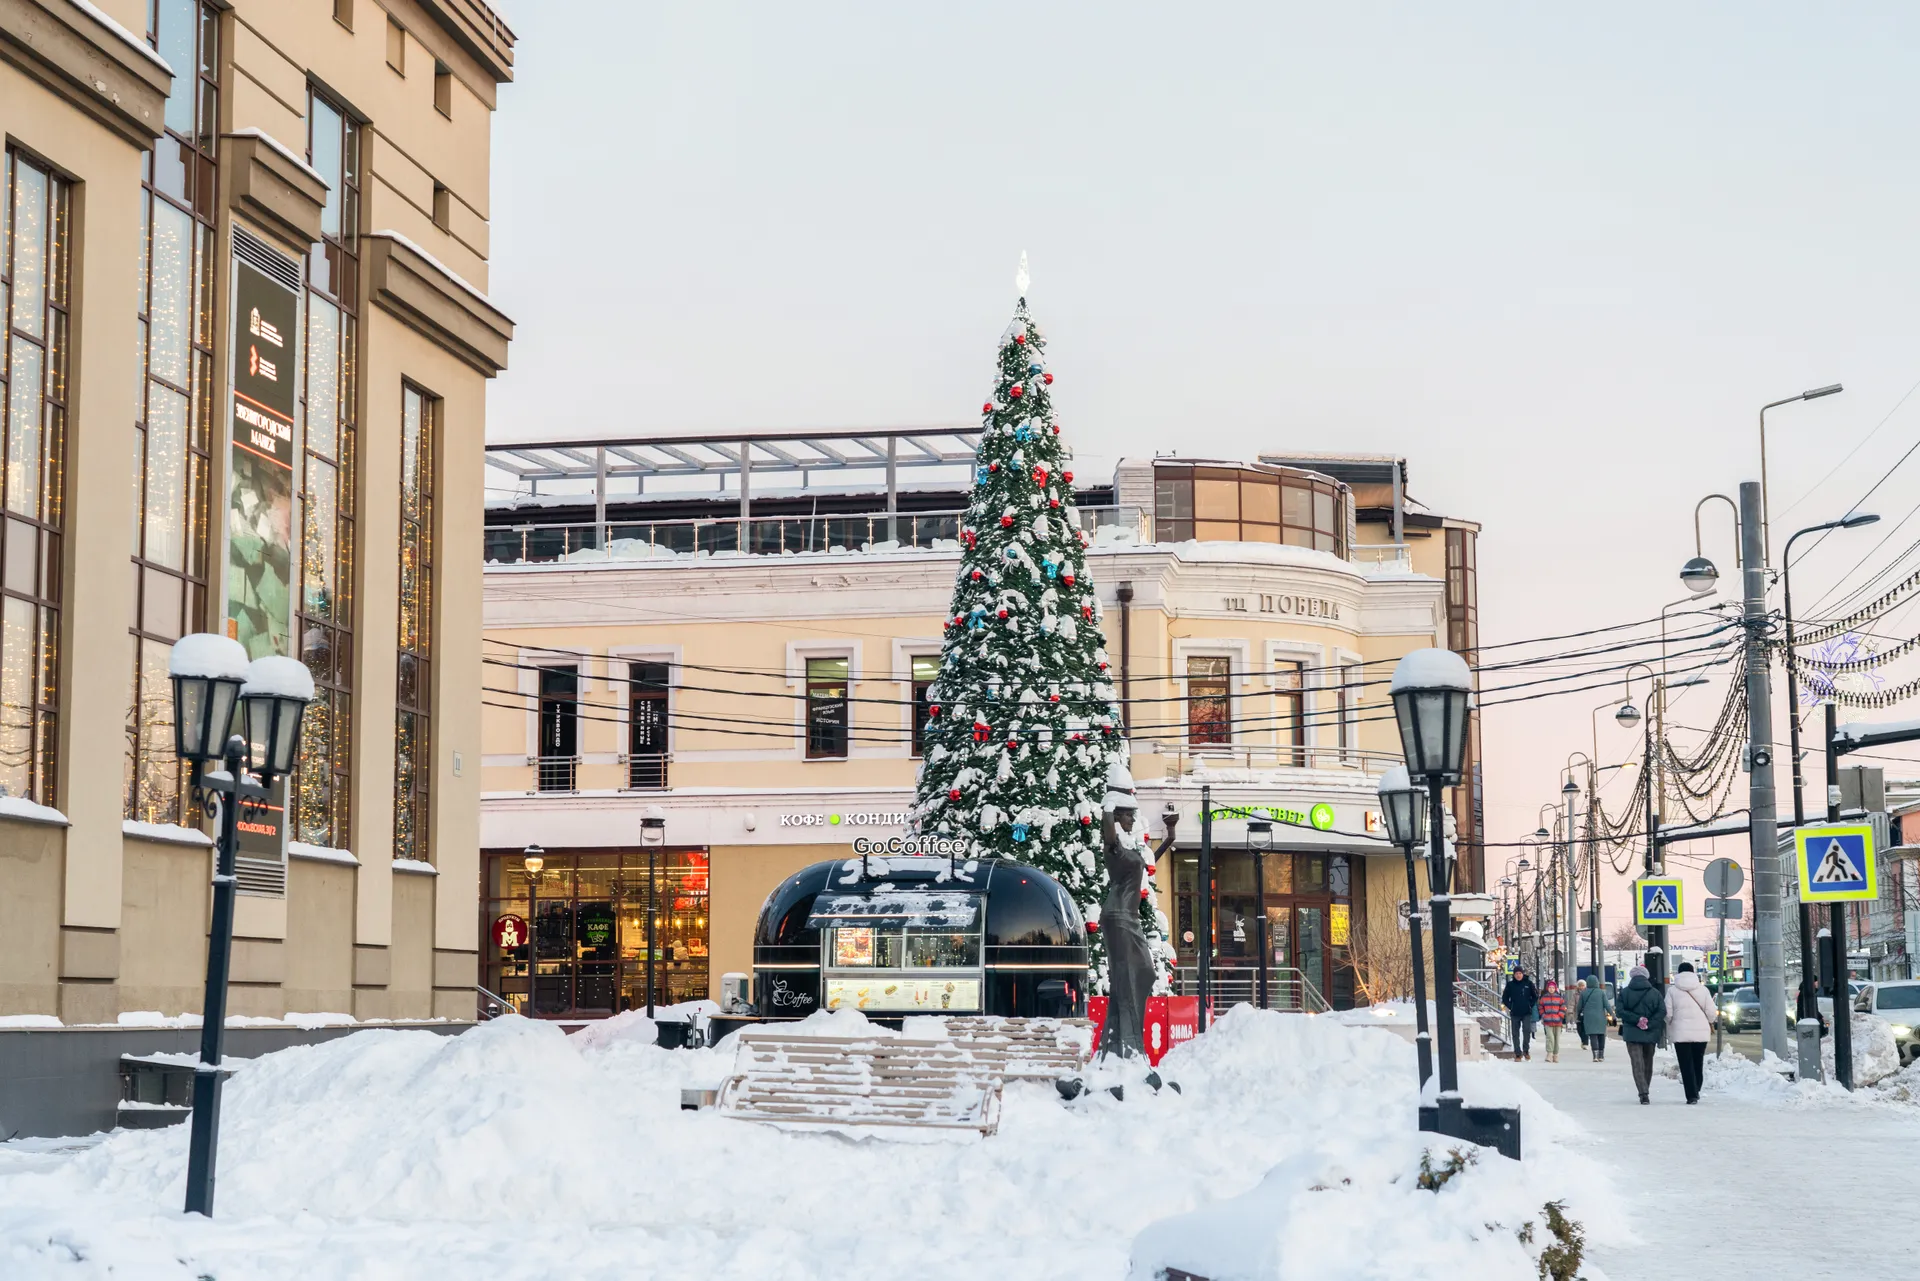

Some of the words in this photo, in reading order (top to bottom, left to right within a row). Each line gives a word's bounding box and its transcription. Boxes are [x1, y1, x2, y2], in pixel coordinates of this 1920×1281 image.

[1223, 596, 1247, 612] ТЦ
[1259, 593, 1341, 621] ПОБЕДА
[780, 813, 825, 827] КОФЕ
[852, 835, 966, 856] GoCoffee
[587, 923, 609, 931] КАФЕ
[783, 988, 813, 1009] Coffee
[1170, 1024, 1194, 1040] ЗИМА
